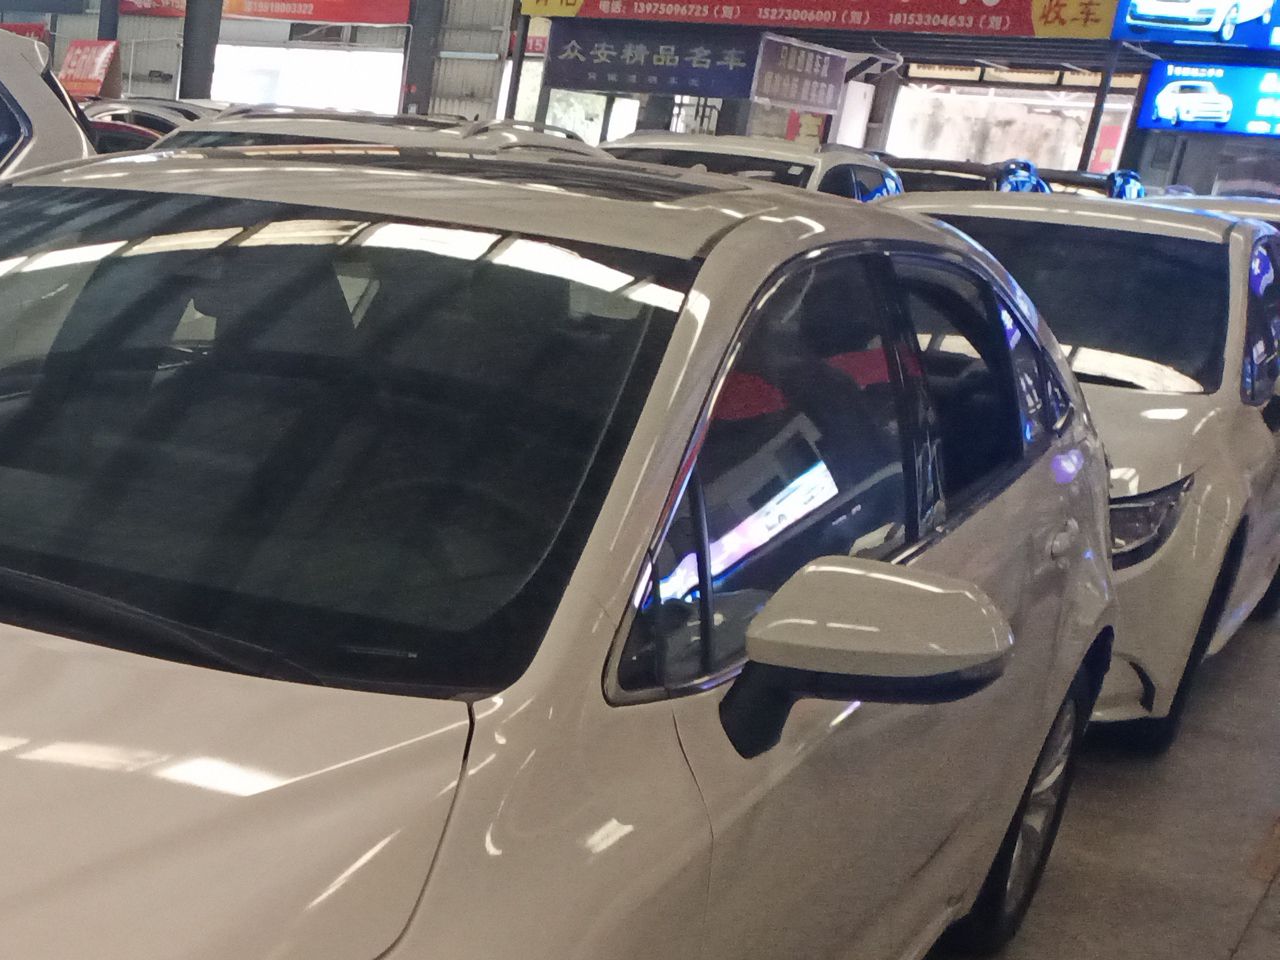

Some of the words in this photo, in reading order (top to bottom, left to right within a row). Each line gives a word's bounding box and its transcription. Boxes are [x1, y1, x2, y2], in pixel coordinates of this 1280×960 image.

[557, 39, 747, 70] 众安精品名车
